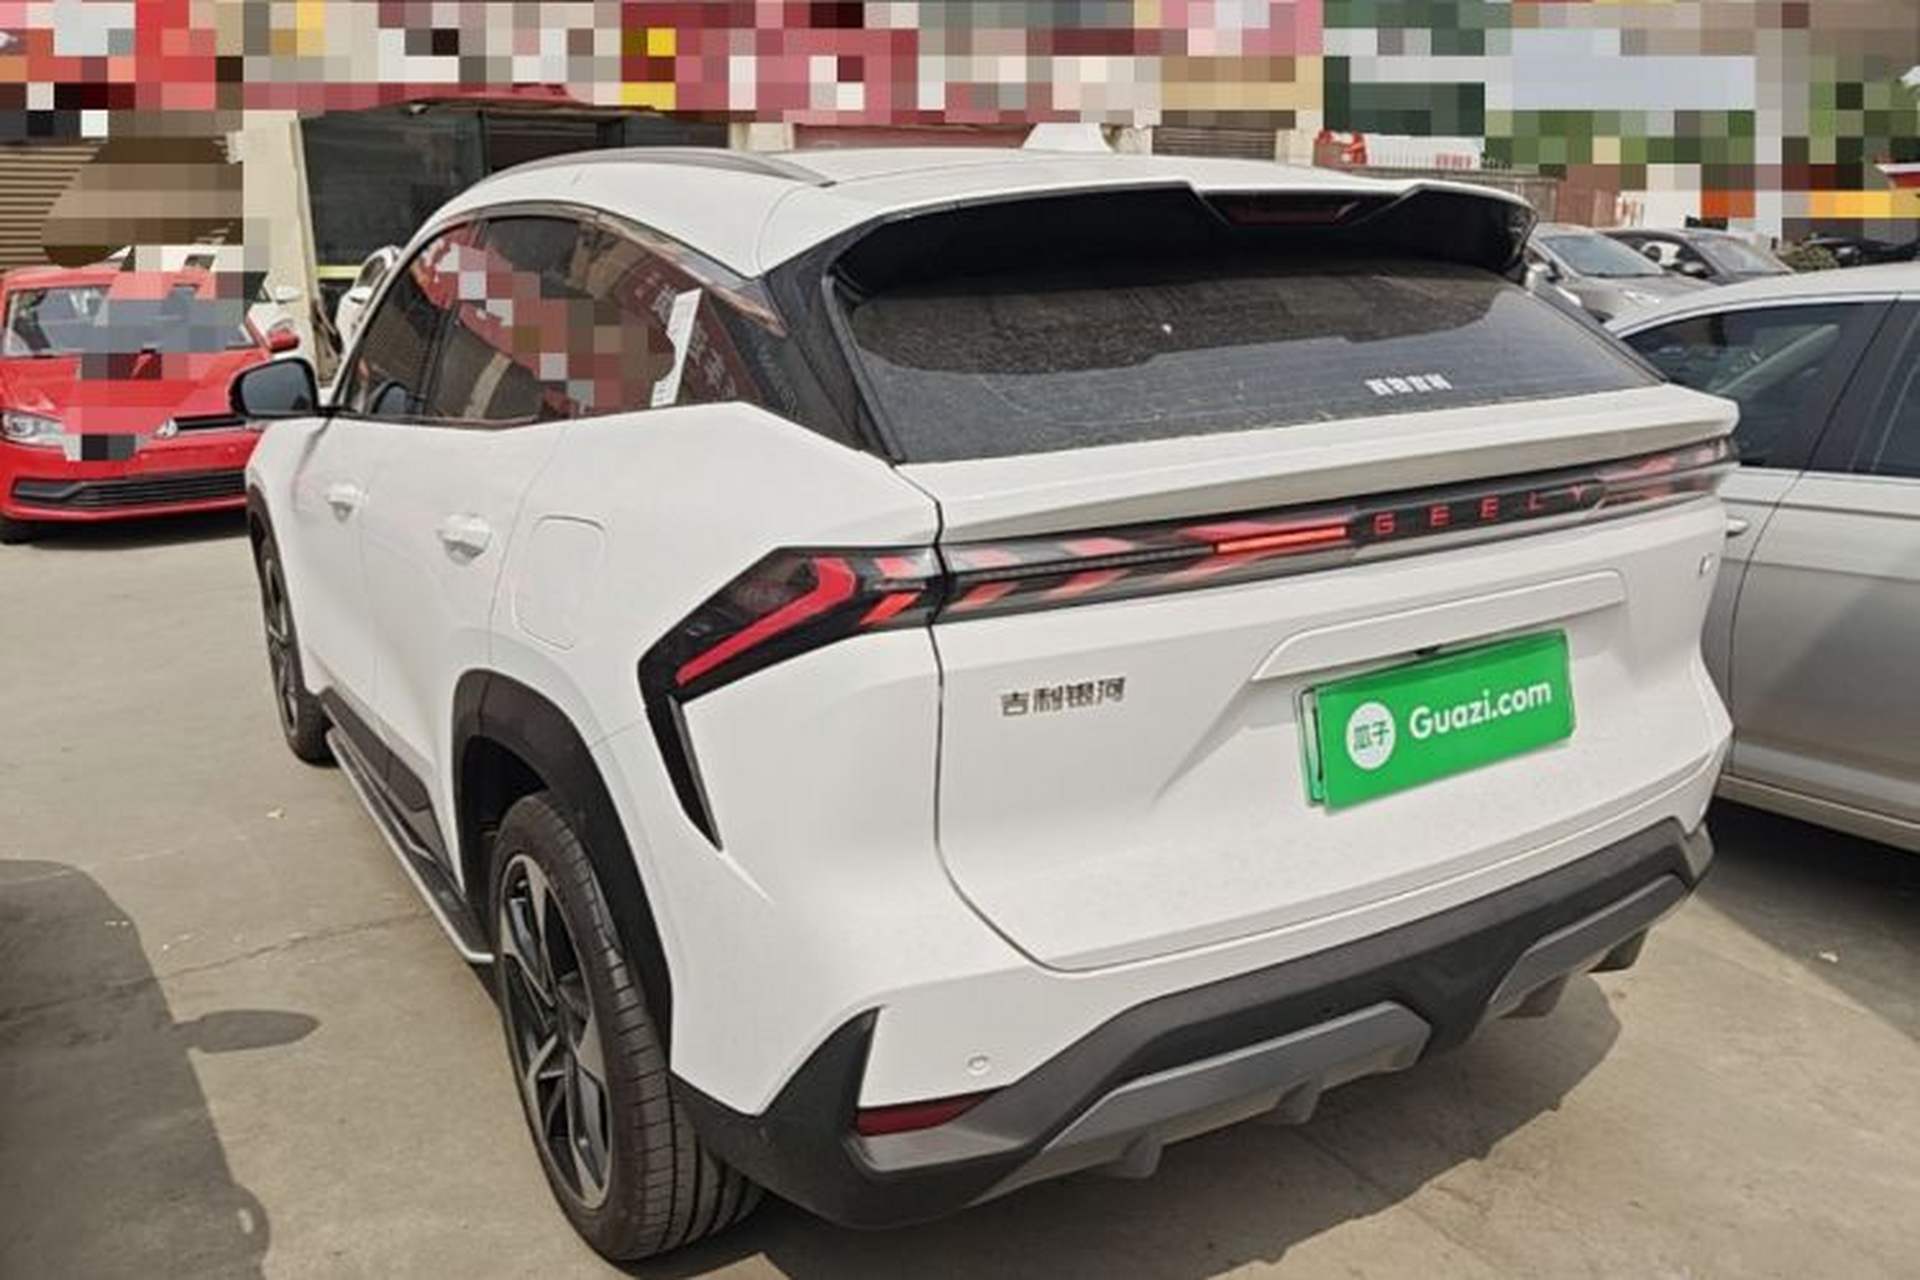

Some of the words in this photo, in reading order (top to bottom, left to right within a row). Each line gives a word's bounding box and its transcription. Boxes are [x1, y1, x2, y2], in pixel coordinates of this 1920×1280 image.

[1374, 485, 1585, 535] GEELY
[1001, 677, 1125, 716] 吉利银河
